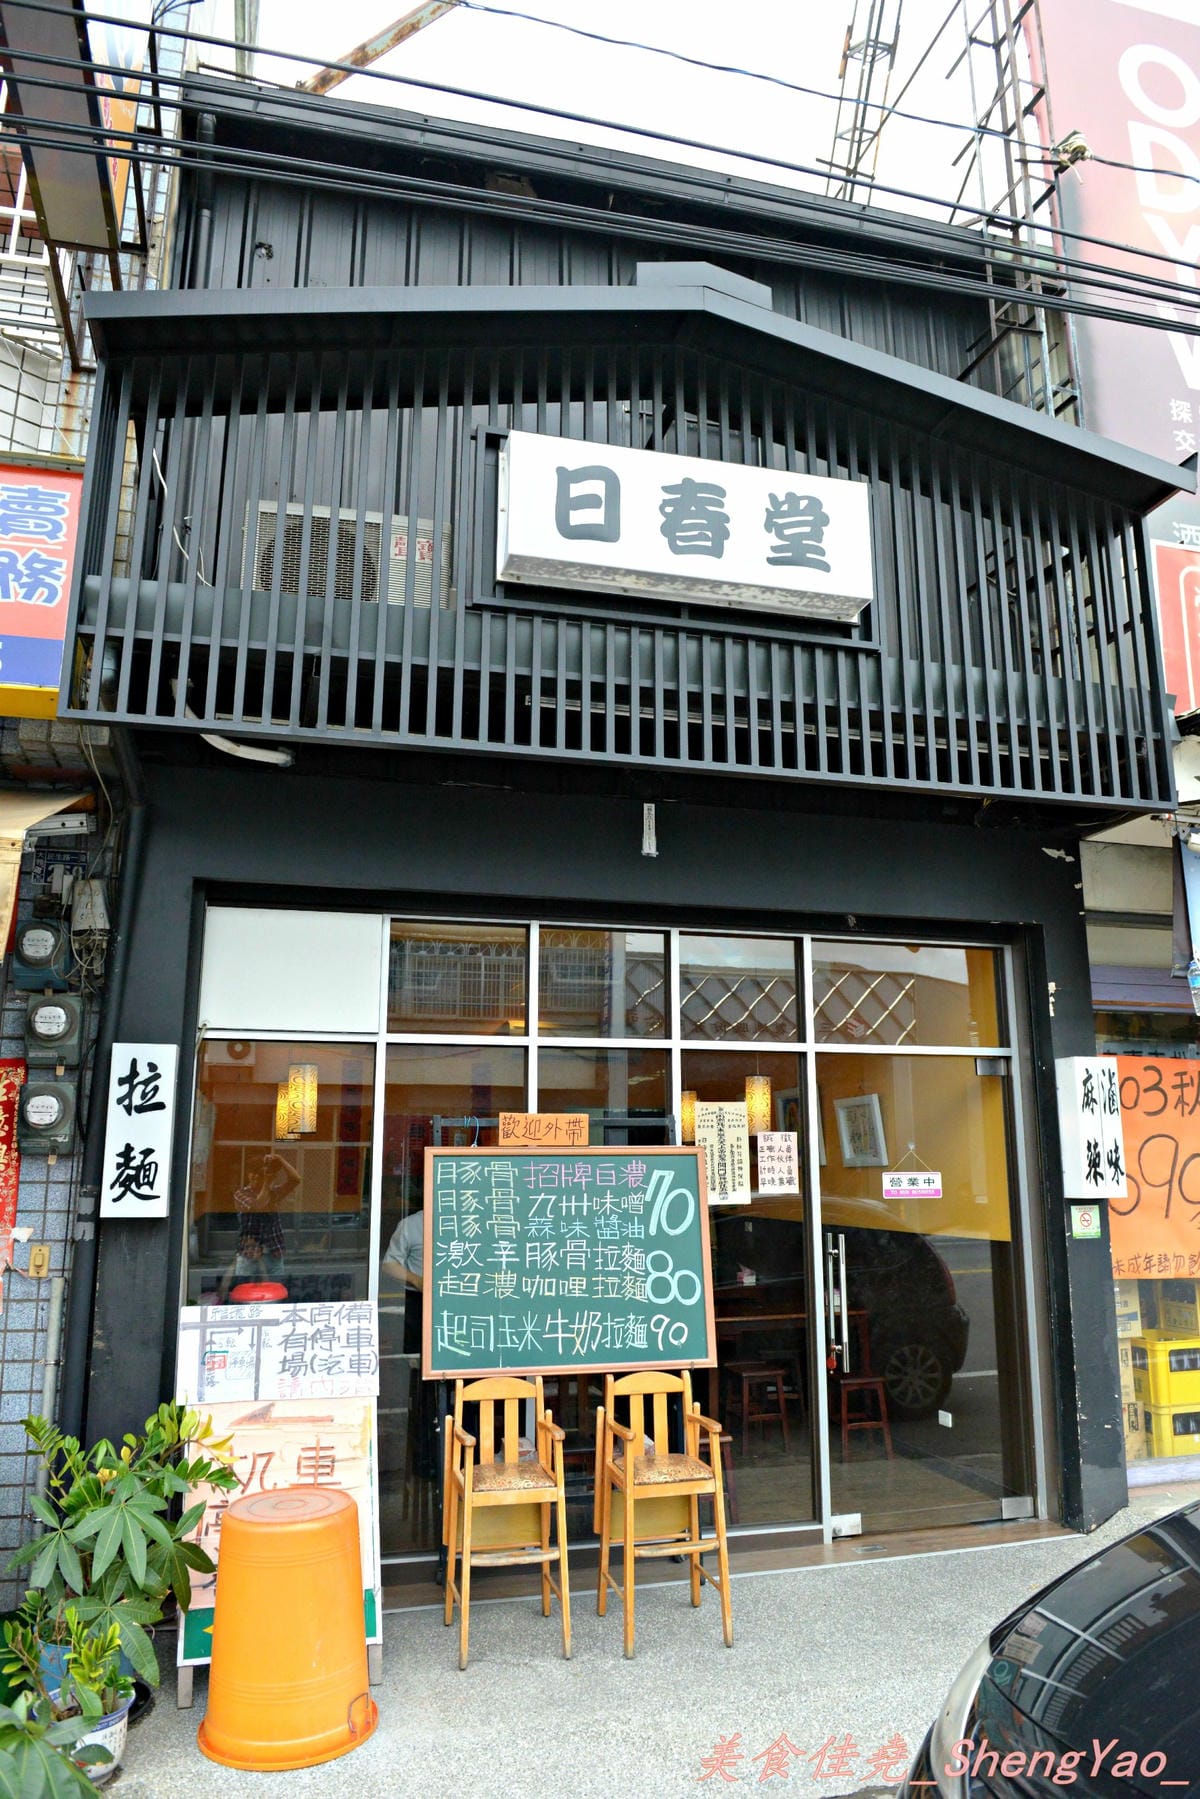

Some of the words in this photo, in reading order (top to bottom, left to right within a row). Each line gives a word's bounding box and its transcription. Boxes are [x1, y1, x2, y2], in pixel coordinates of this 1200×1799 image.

[555, 465, 831, 573] 日春堂
[110, 1057, 166, 1202] 拉麵
[501, 1113, 584, 1146] 歡迎外帶
[644, 1168, 696, 1236] 70
[889, 1176, 935, 1188] 營業中
[646, 1250, 702, 1306] 80
[279, 1302, 374, 1326] 本店備
[434, 1308, 648, 1356] 起司玉米牛奶拉麵
[650, 1313, 689, 1352] 90
[277, 1324, 375, 1352] 有停車
